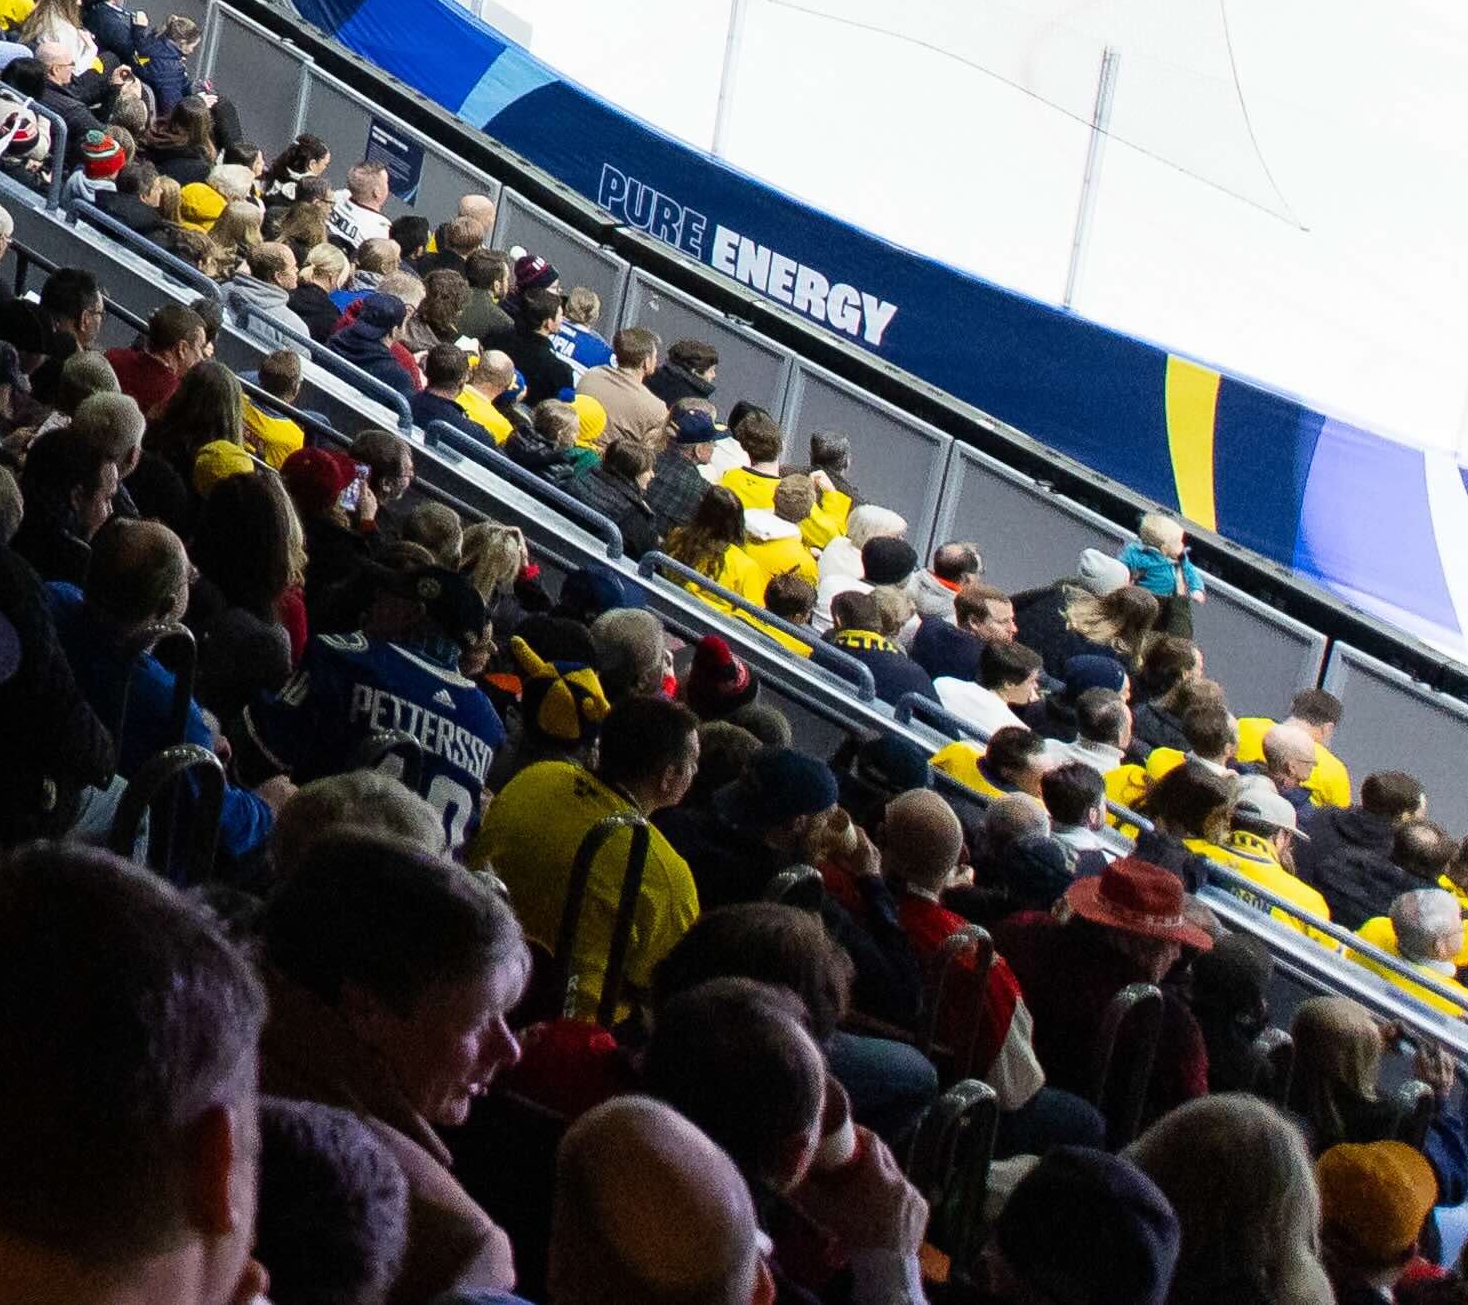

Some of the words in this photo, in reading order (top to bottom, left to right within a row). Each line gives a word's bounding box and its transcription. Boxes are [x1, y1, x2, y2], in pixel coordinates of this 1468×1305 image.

[597, 162, 708, 262] PURE
[710, 223, 898, 347] ENERGY
[352, 683, 493, 784] PETTERSSO
